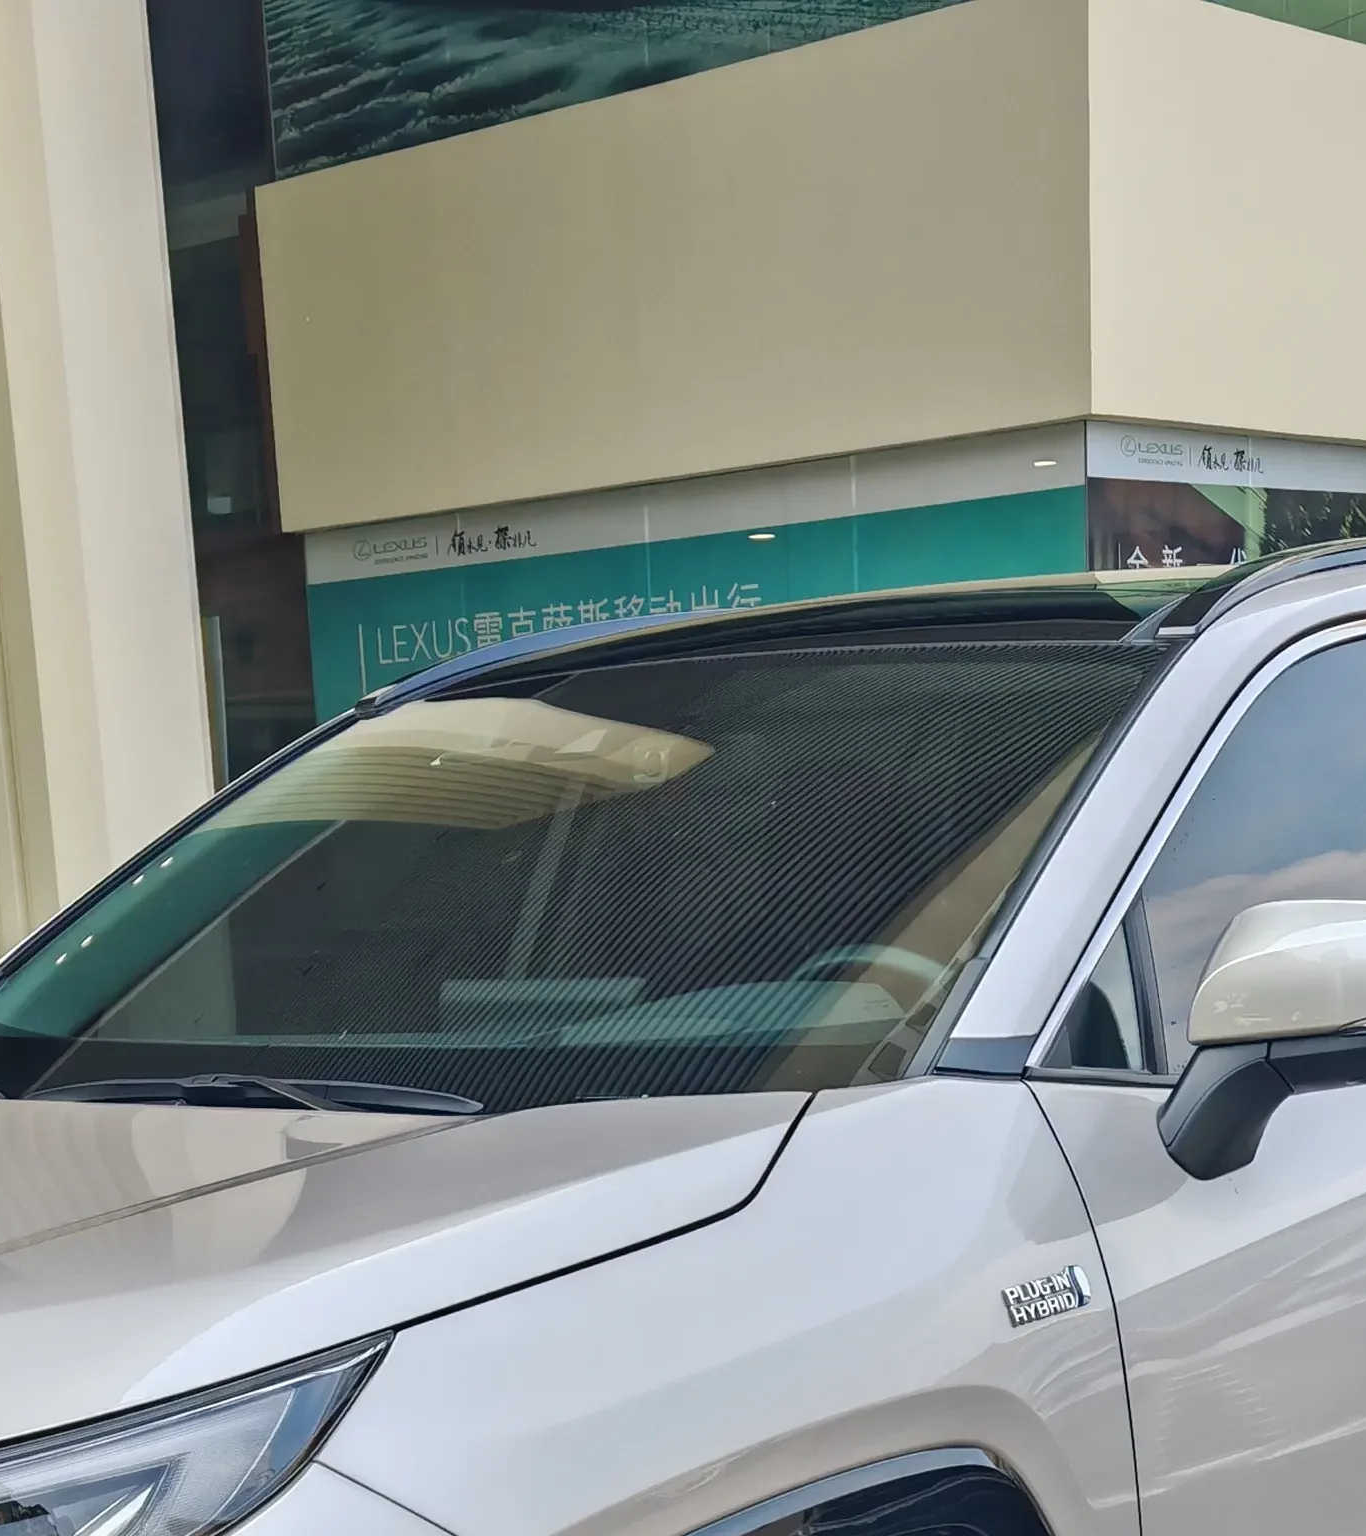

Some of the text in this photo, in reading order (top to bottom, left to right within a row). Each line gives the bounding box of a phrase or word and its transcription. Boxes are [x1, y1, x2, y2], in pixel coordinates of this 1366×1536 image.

[1138, 442, 1184, 456] LEXUS
[372, 536, 428, 555] LEXUS
[1004, 1271, 1071, 1305] PLUG-IN
[1010, 1291, 1078, 1324] HYBRID
